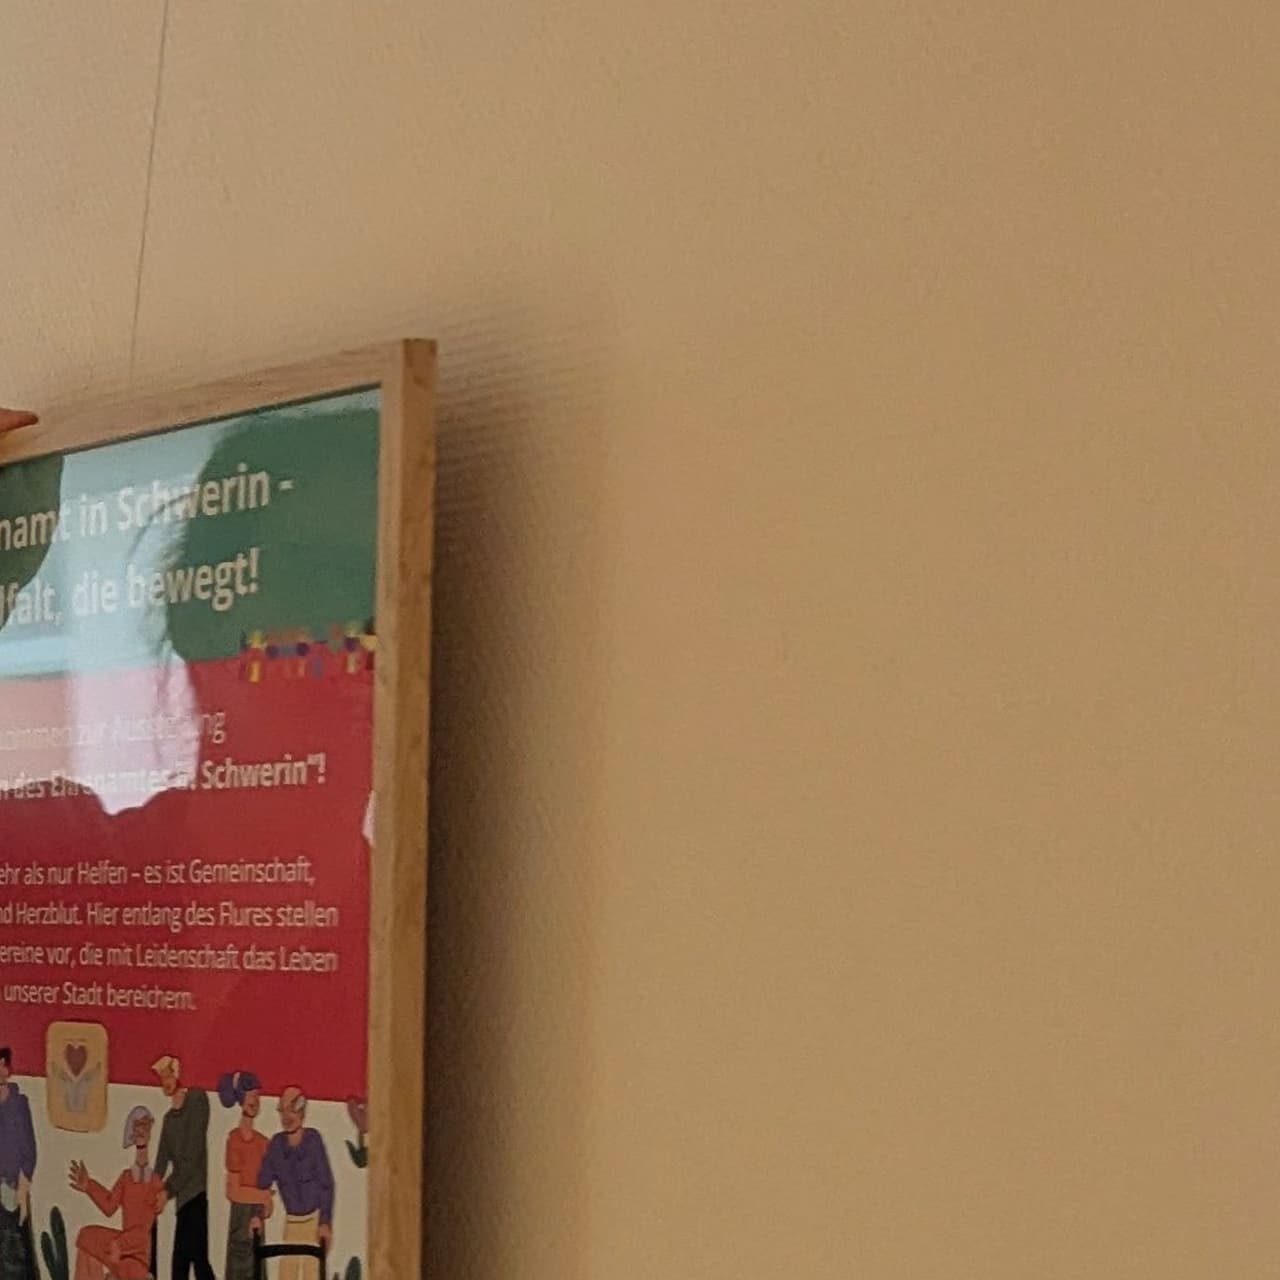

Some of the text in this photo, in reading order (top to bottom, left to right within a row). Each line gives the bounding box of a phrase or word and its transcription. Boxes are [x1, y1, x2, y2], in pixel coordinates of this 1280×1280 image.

[79, 496, 109, 537] in
[118, 462, 272, 532] Schwerin
[73, 570, 118, 617] die
[126, 546, 261, 613] bewegt!
[24, 862, 44, 885] als
[47, 865, 74, 885] nur
[78, 859, 128, 885] Helfen
[144, 865, 162, 884] es
[167, 860, 185, 884] ist
[190, 856, 315, 886] Gemeinschaft,
[16, 901, 83, 925] Herzblut.
[88, 902, 119, 925] Hier
[122, 901, 183, 934] entlang
[186, 901, 214, 926] des
[219, 901, 273, 927] Flures
[276, 900, 339, 928] stellen
[48, 945, 76, 969] vor,
[79, 943, 103, 966] die
[106, 942, 133, 967] mit
[137, 943, 240, 970] Leidenschaft
[243, 943, 276, 971] das
[280, 946, 338, 972] Leben
[4, 984, 59, 1004] unserer
[63, 981, 102, 1006] Stadt
[106, 982, 198, 1010] bereichern.
